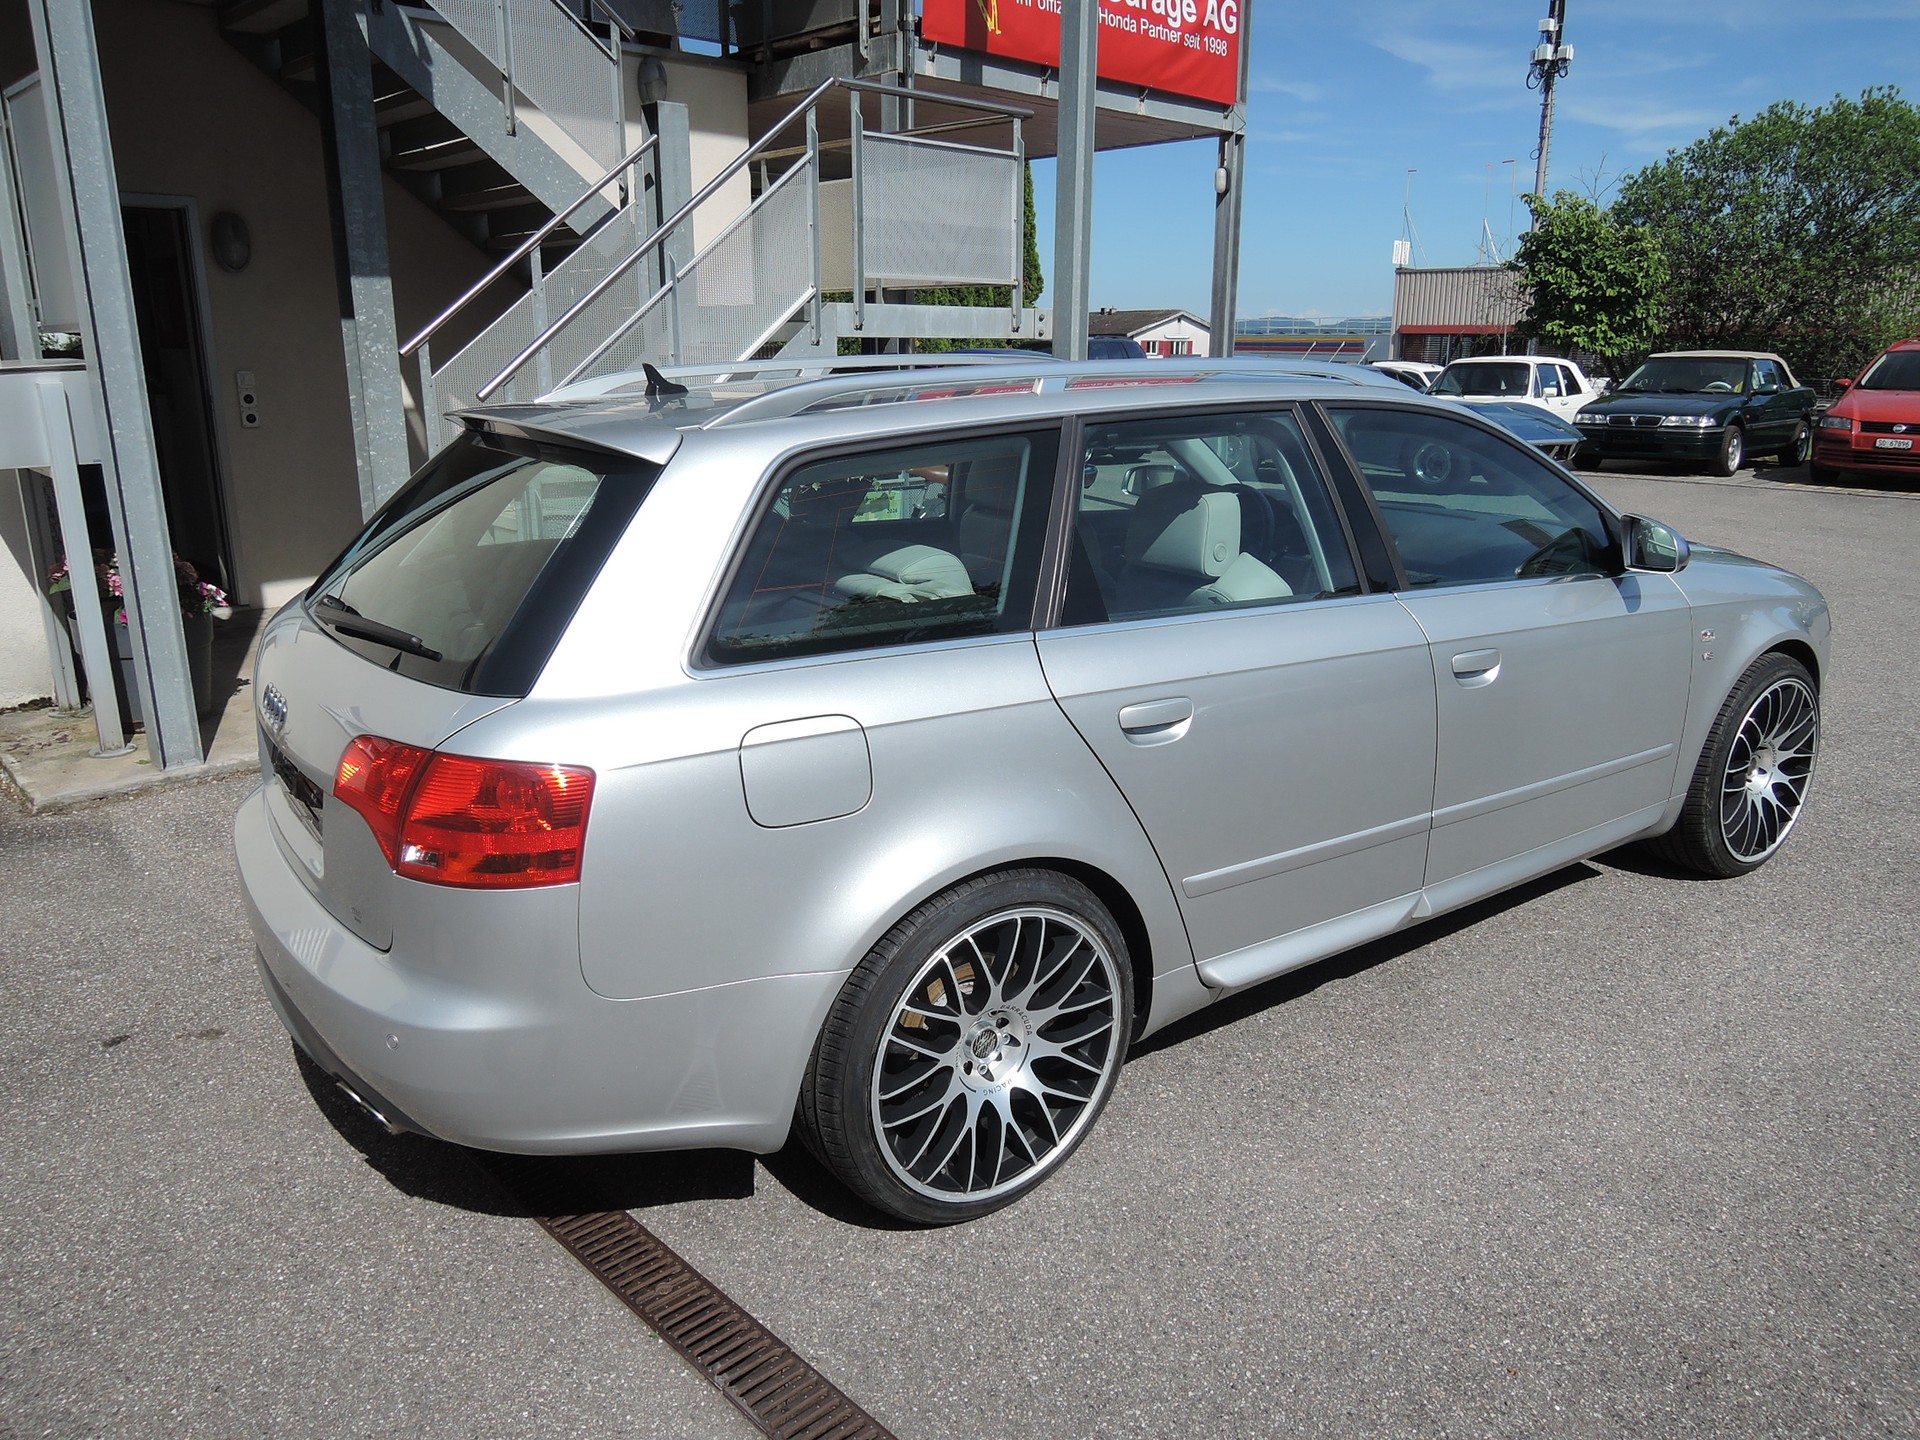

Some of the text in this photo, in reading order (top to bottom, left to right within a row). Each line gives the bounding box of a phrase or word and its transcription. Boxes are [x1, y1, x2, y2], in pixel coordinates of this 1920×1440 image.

[1098, 7, 1137, 33] Honda
[1140, 18, 1182, 44] Partner
[1184, 33, 1200, 50] seit
[1203, 36, 1228, 57] 1998
[1106, 0, 1237, 34] age AG
[1000, 1004, 1033, 1036] BARRACUDA
